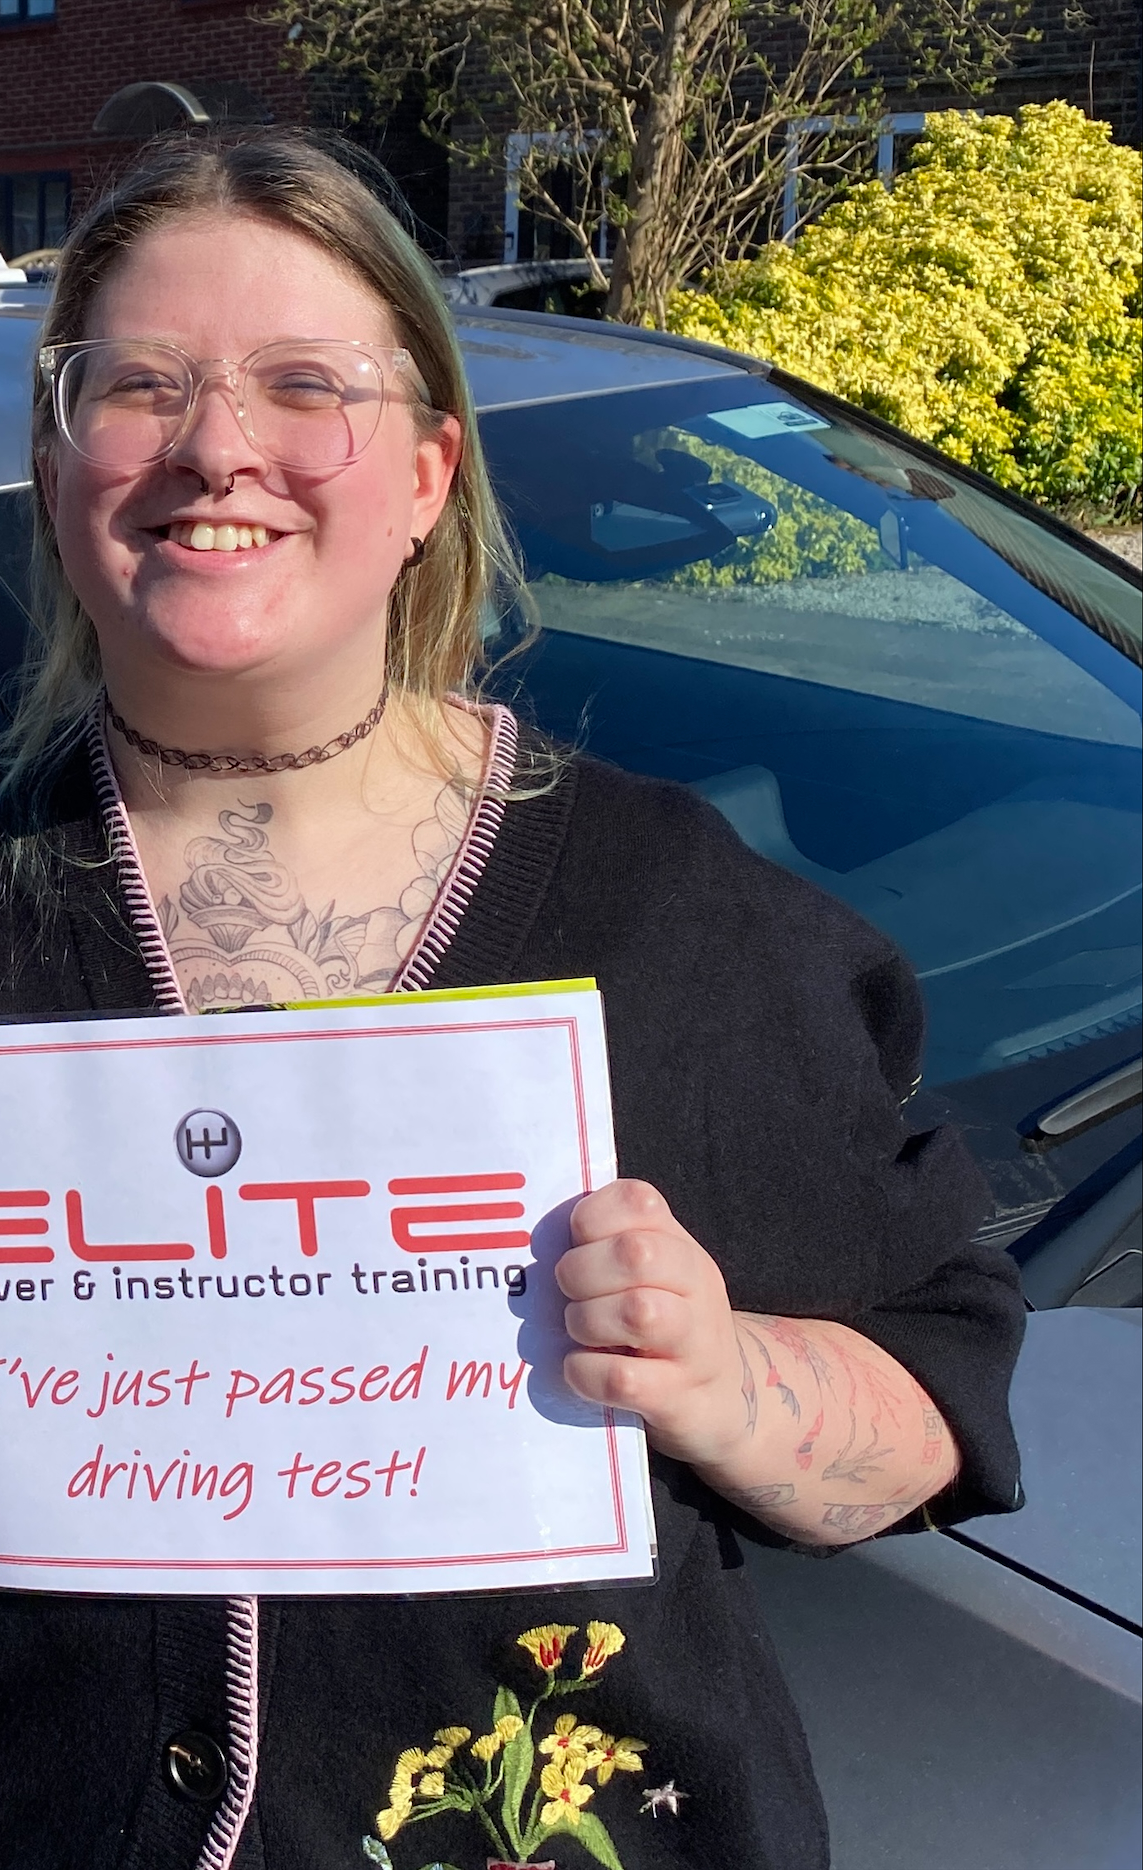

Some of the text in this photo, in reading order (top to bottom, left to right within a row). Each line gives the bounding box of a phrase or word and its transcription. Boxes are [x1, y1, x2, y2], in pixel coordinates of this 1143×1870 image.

[73, 1270, 96, 1301] &
[113, 1266, 332, 1300] instructor
[351, 1257, 530, 1298] training
[86, 1353, 210, 1419] just
[225, 1346, 429, 1418] passed
[445, 1360, 527, 1410] my
[66, 1445, 427, 1522] driving test!
